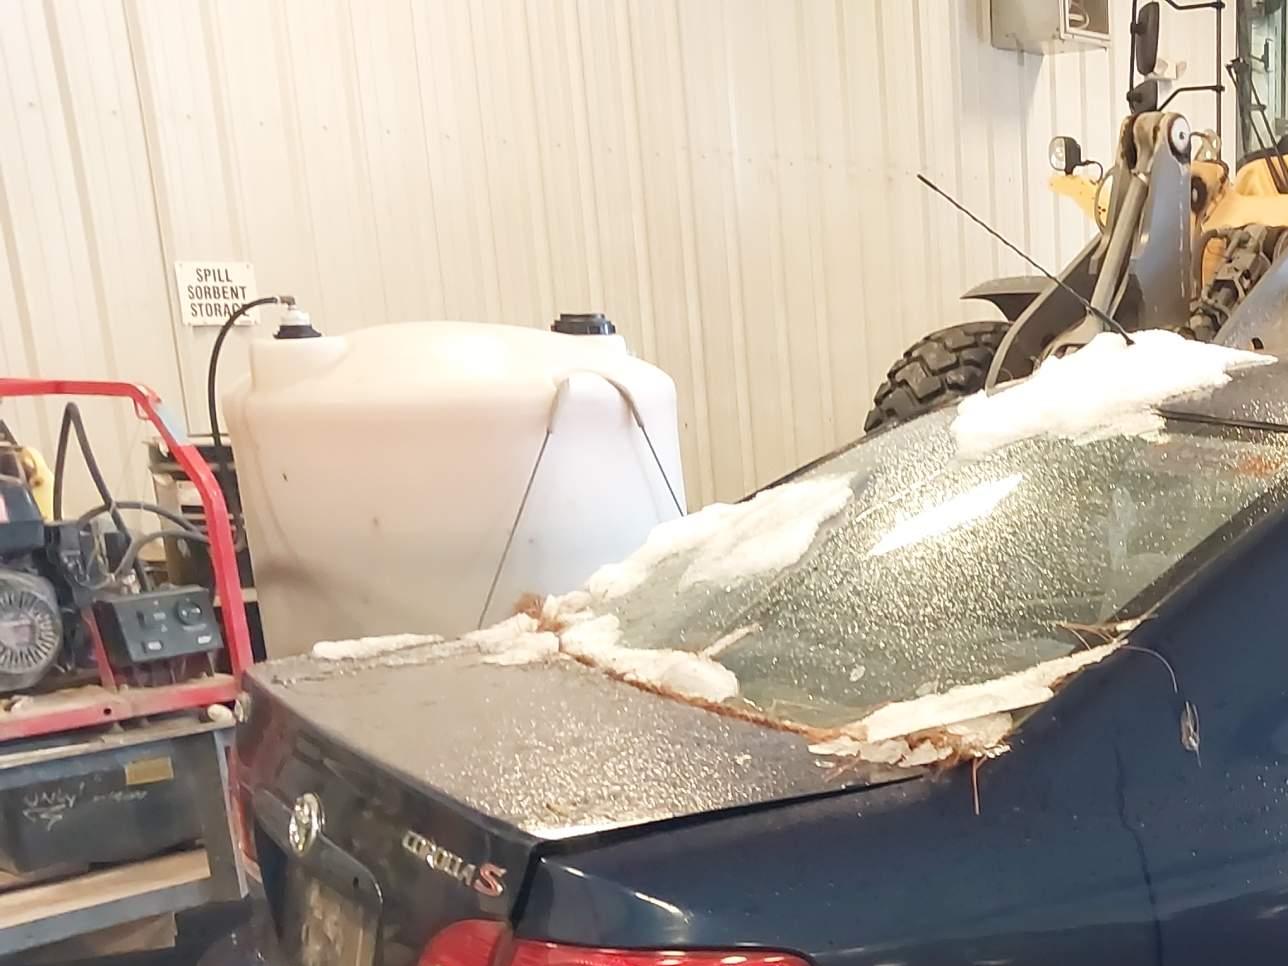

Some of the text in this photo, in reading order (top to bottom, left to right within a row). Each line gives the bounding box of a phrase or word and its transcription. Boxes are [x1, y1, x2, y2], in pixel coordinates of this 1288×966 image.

[195, 268, 232, 282] SPILL
[187, 285, 247, 300] SORBENT
[190, 302, 250, 317] STORA
[472, 863, 507, 897] S
